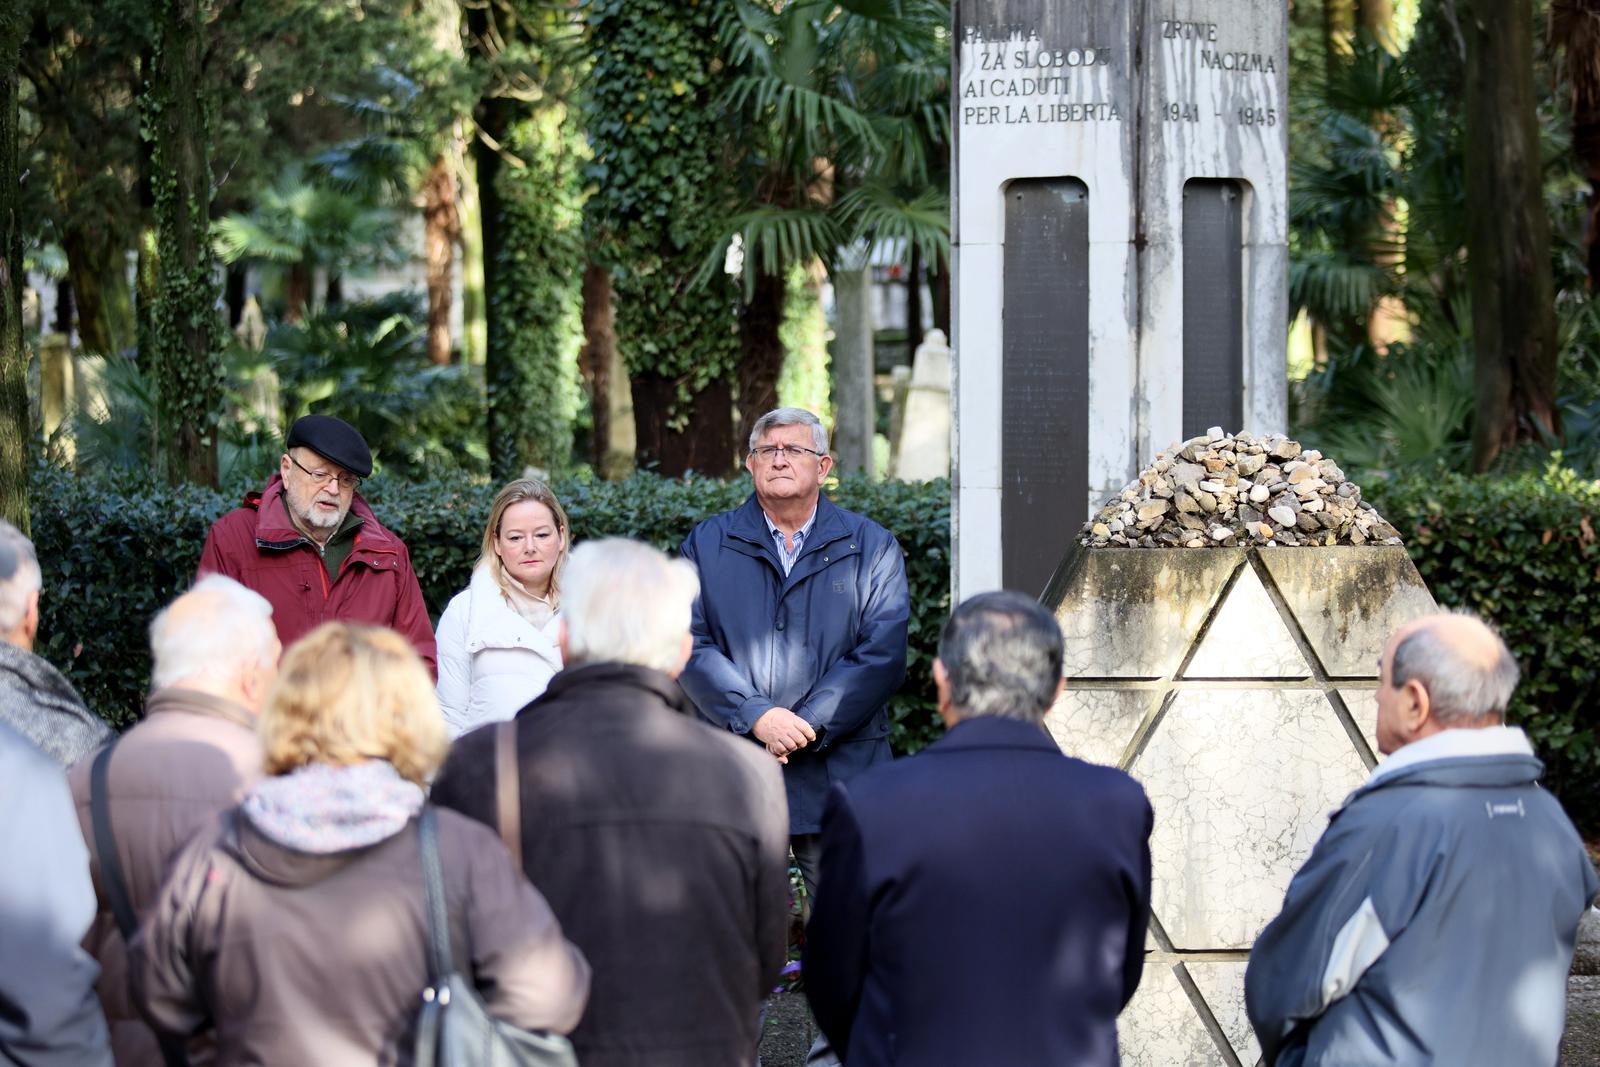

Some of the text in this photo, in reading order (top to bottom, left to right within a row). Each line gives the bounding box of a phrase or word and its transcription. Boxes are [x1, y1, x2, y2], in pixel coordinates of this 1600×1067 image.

[980, 51, 1006, 70] ZA
[1200, 50, 1276, 73] NACIZMA
[990, 77, 1070, 97] CADUTI
[964, 106, 1000, 125] PER
[1005, 105, 1032, 124] LA
[1162, 103, 1199, 122] 1941
[1237, 107, 1276, 126] 1945
